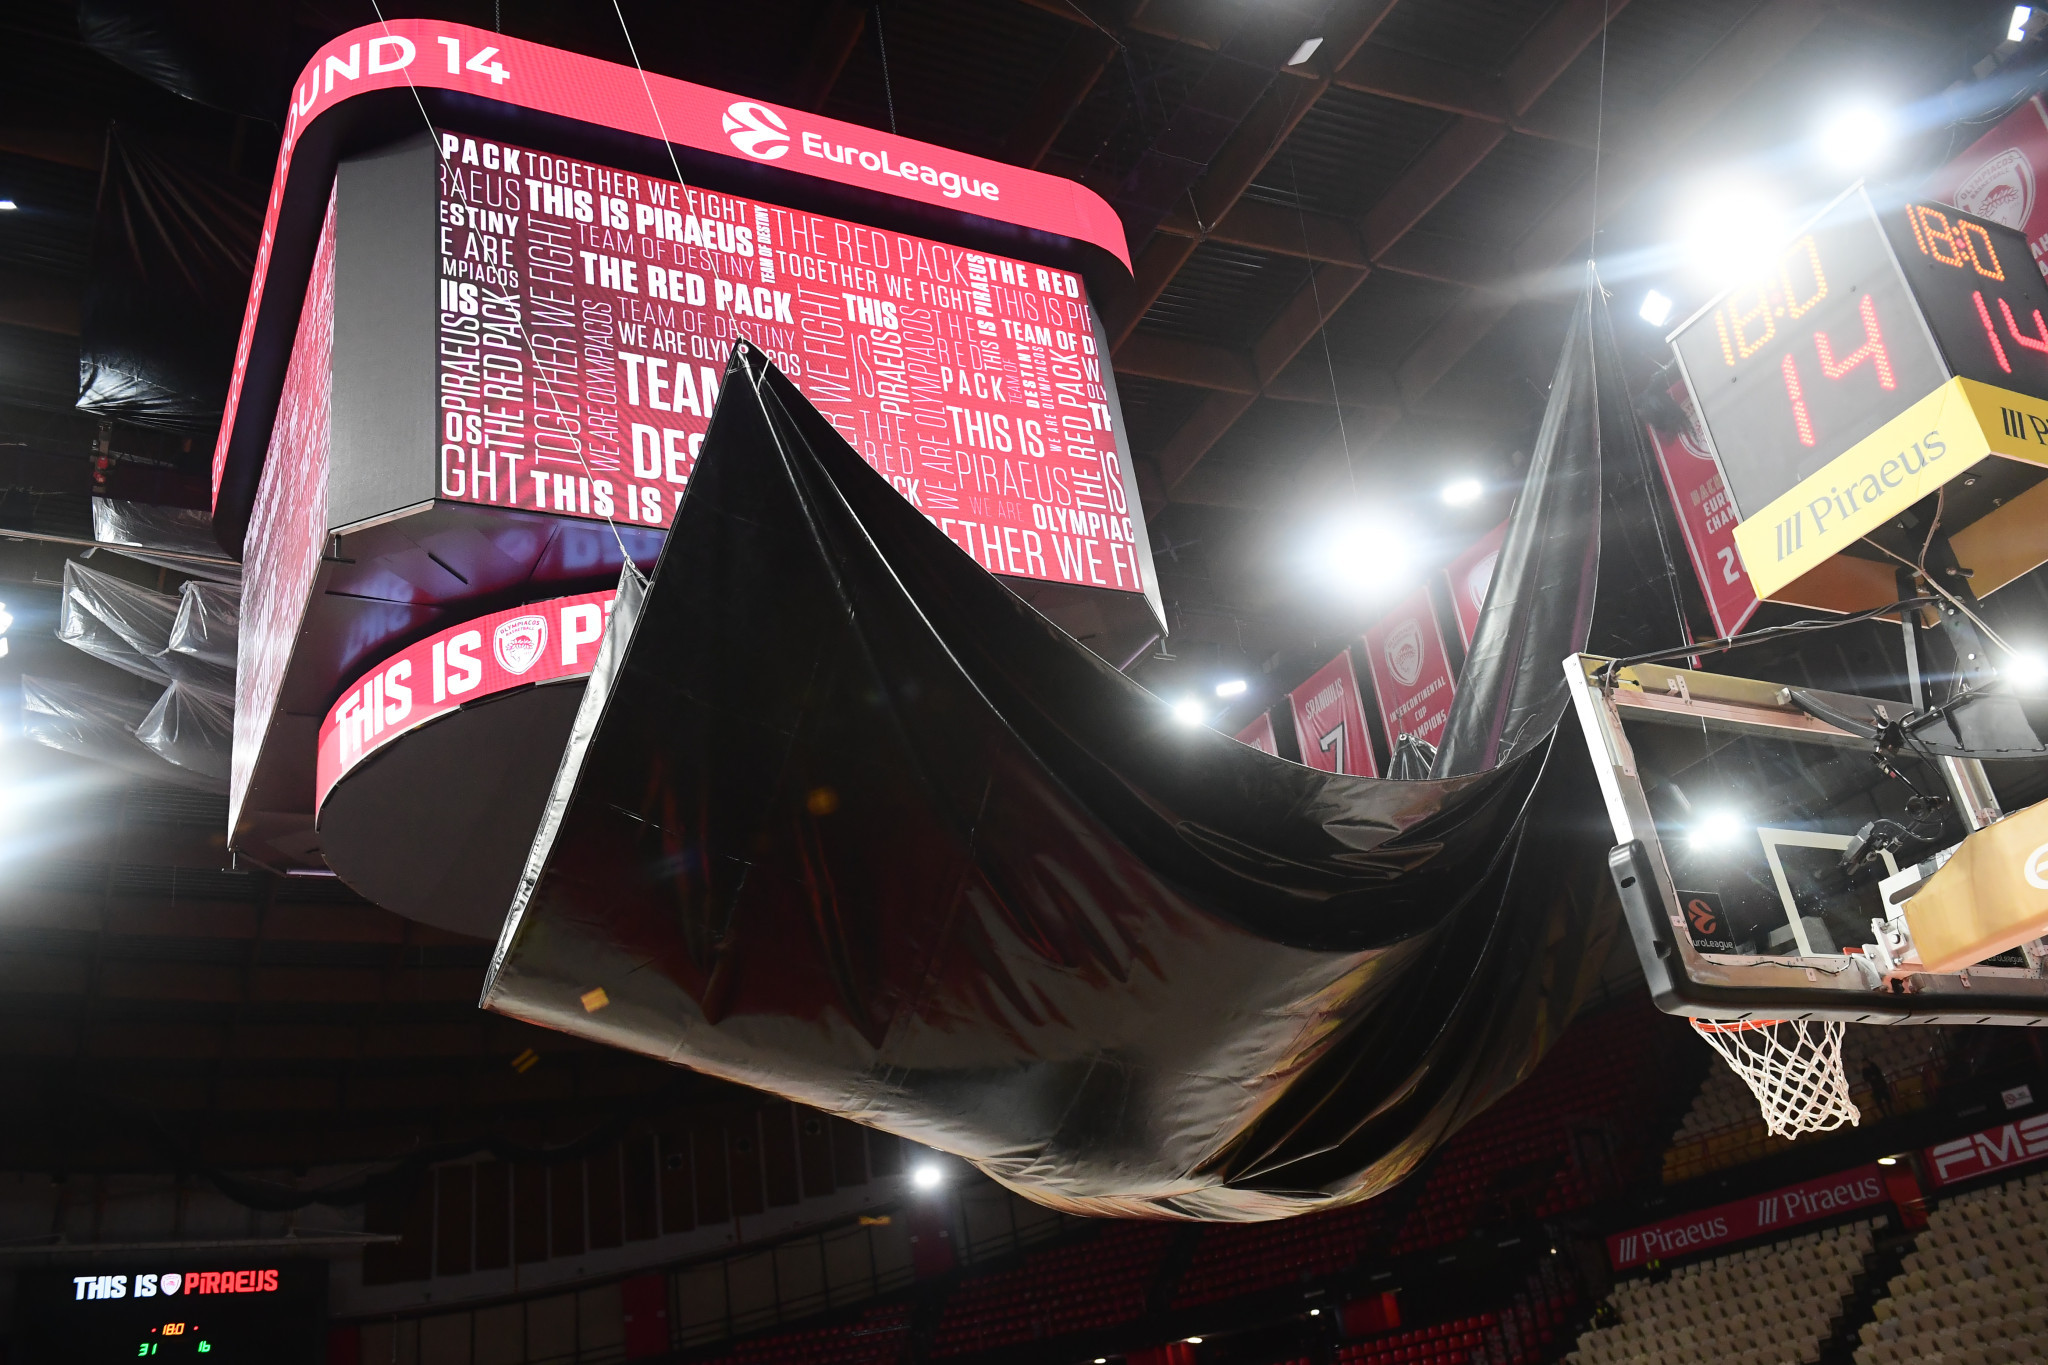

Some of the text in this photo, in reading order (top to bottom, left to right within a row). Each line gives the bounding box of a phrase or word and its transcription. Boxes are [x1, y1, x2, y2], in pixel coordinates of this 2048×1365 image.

[281, 35, 511, 187] ROUND 14
[442, 133, 521, 175] PACK
[802, 131, 1000, 201] EuroLeague
[525, 152, 747, 224] TOGETHER WE FIGHT
[440, 200, 519, 237] ESTINY
[525, 178, 754, 258] THIS IS PIRAEUS
[754, 204, 776, 284] TEAM OF DESTINY
[443, 257, 519, 288] MPIACOS
[464, 232, 514, 268] ARE
[576, 222, 754, 280] TEAM OF DESTINY
[771, 208, 969, 287] THE RED PACK
[580, 251, 795, 325] THE RED PACK
[776, 250, 974, 313] TOGETHER WE FIGHT
[985, 257, 1080, 299] THE RED
[617, 296, 675, 329] TEAM
[682, 310, 706, 334] OF
[797, 283, 847, 360] FIGHT
[842, 293, 899, 330] THIS
[932, 310, 977, 342] THE
[966, 253, 1003, 371] THIS IS PIRAEUS
[991, 285, 1039, 322] THIS
[1043, 296, 1063, 327] IS
[441, 313, 481, 413] PIRAEUS
[527, 213, 582, 465] TOGETHER WE FIGHT
[617, 321, 648, 349] WE
[653, 327, 687, 356] ARE
[937, 338, 983, 371] RED
[1001, 319, 1099, 356] TEAM OF D
[482, 287, 525, 448] THE RED PACK
[582, 300, 621, 472] WE ARE OLYMPIACOS
[806, 360, 852, 403] WE
[870, 328, 912, 416] PIRAEUS
[941, 366, 1006, 403] PACK
[1016, 342, 1041, 409] DESTINY
[1032, 345, 1055, 410] OLYMPIACOS
[1781, 293, 1897, 447] 14
[446, 412, 482, 445] OS
[858, 410, 908, 445] THE
[900, 305, 960, 510] WE ARE OLYMPIACOS
[946, 405, 1045, 458] THIS IS
[1049, 349, 1107, 510] THE RED PACK
[2026, 414, 2048, 446] P
[441, 443, 525, 504] GHT
[865, 440, 914, 475] RED
[955, 450, 1071, 506] PIRAEUS
[1806, 429, 1947, 535] Piraeus
[530, 470, 615, 517] THIS
[628, 484, 663, 524] IS
[969, 495, 1135, 543] WE ARE OLYMPIAC
[1051, 534, 1106, 585] WE
[1109, 542, 1140, 590] FI
[336, 659, 412, 764] THIS
[432, 630, 482, 704] IS
[1414, 705, 1427, 722] CUP
[1320, 721, 1345, 774] 7
[1410, 709, 1447, 739] AMPIONS
[1693, 938, 1734, 951] uroLeague
[1783, 1177, 1881, 1219] Piraeus
[1641, 1216, 1729, 1254] Piraeus
[73, 1275, 128, 1300] THIS
[134, 1274, 158, 1298] IS
[137, 1342, 158, 1357] 31
[198, 1340, 211, 1353] 16
